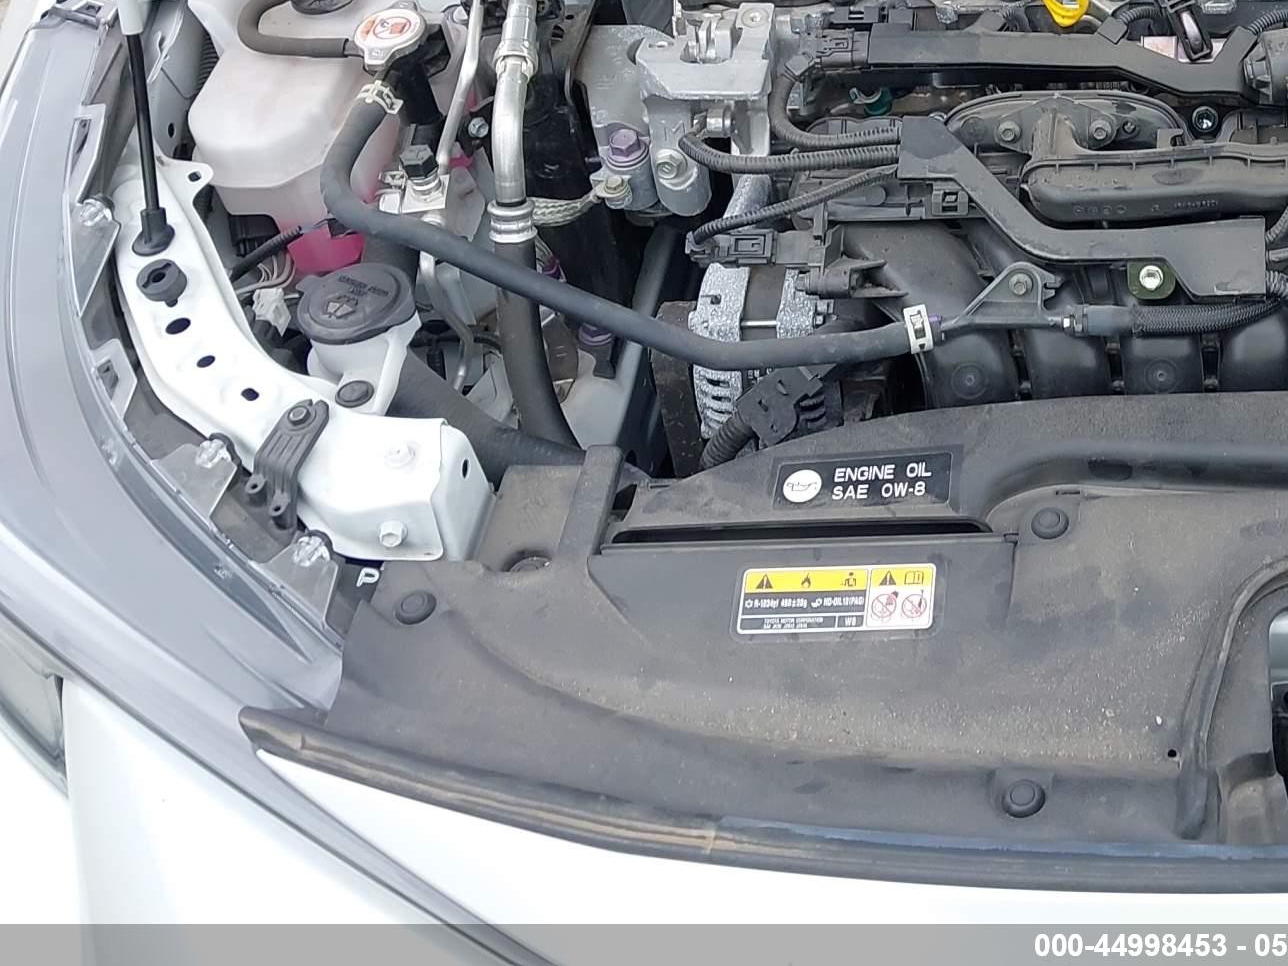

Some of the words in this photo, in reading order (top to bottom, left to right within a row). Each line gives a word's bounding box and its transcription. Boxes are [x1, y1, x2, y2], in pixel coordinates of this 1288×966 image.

[833, 464, 896, 482] ENGINE
[906, 461, 932, 478] OIL
[831, 484, 869, 500] SAE
[881, 481, 926, 498] 0W-8
